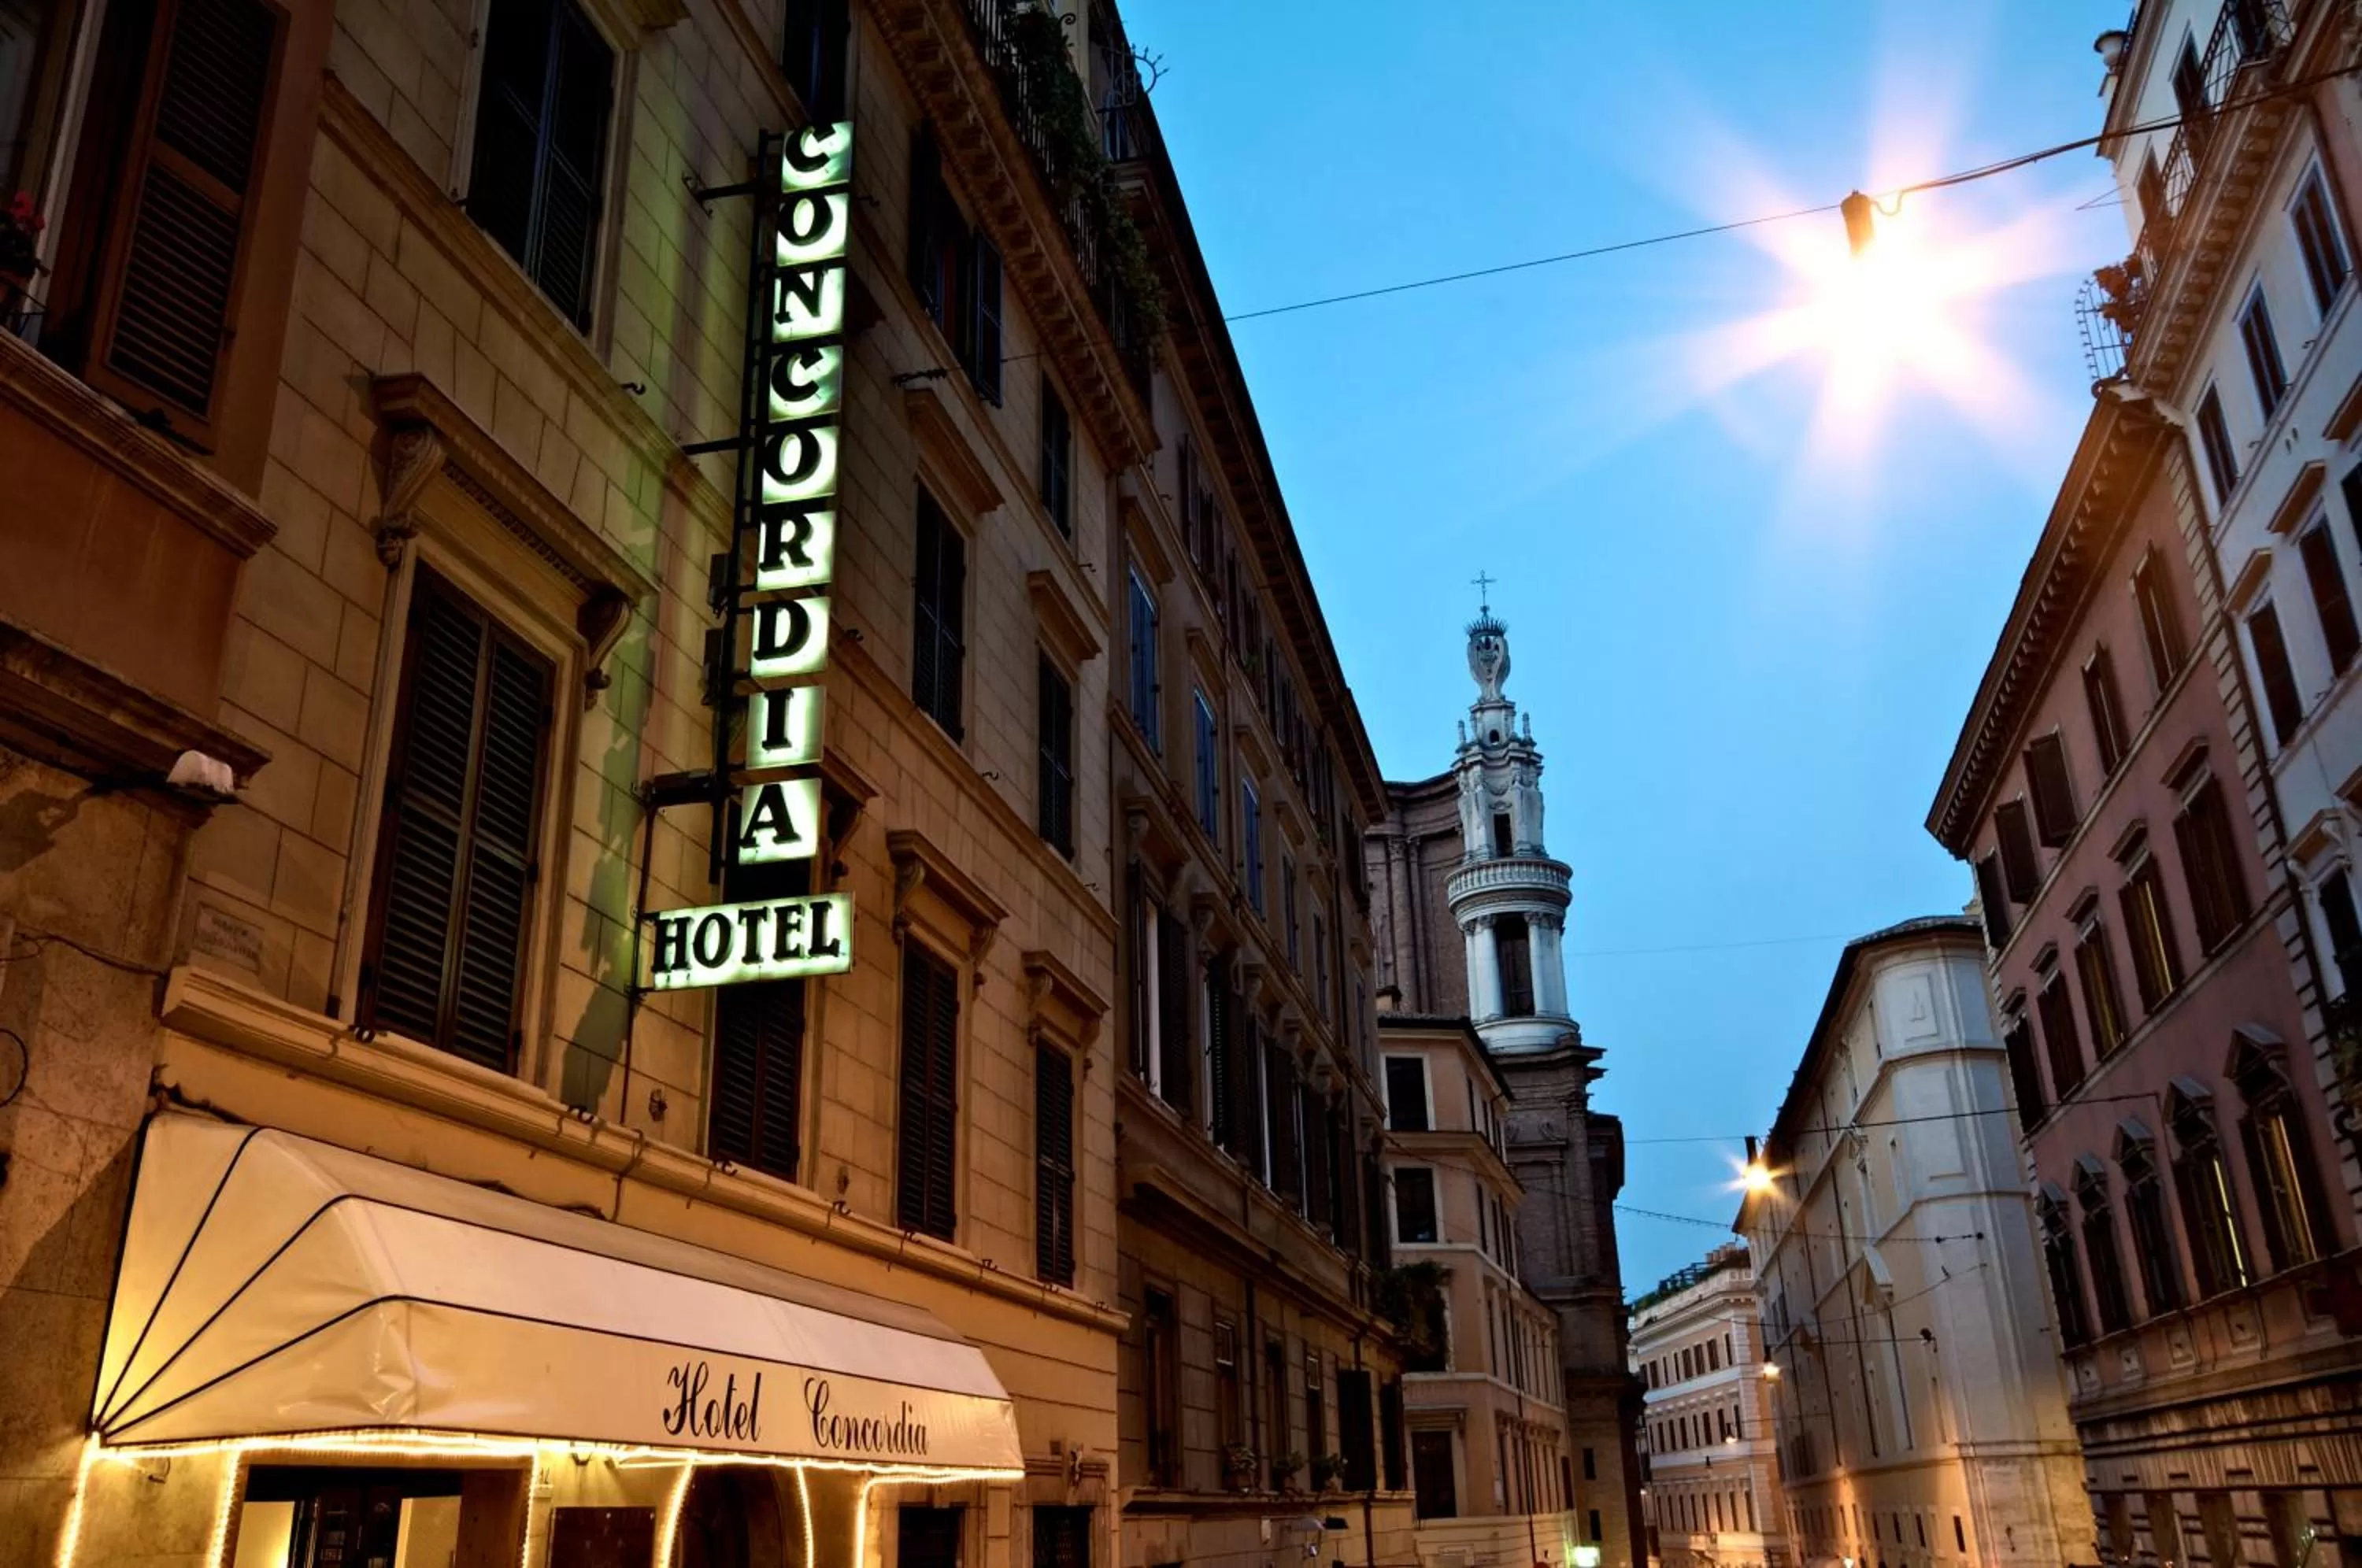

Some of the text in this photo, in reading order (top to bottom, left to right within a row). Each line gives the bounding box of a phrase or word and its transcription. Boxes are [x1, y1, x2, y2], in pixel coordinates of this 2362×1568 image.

[741, 120, 836, 849] CONCORDIA
[653, 900, 840, 974] HOTEL
[663, 1361, 930, 1456] Hotel Concordia
